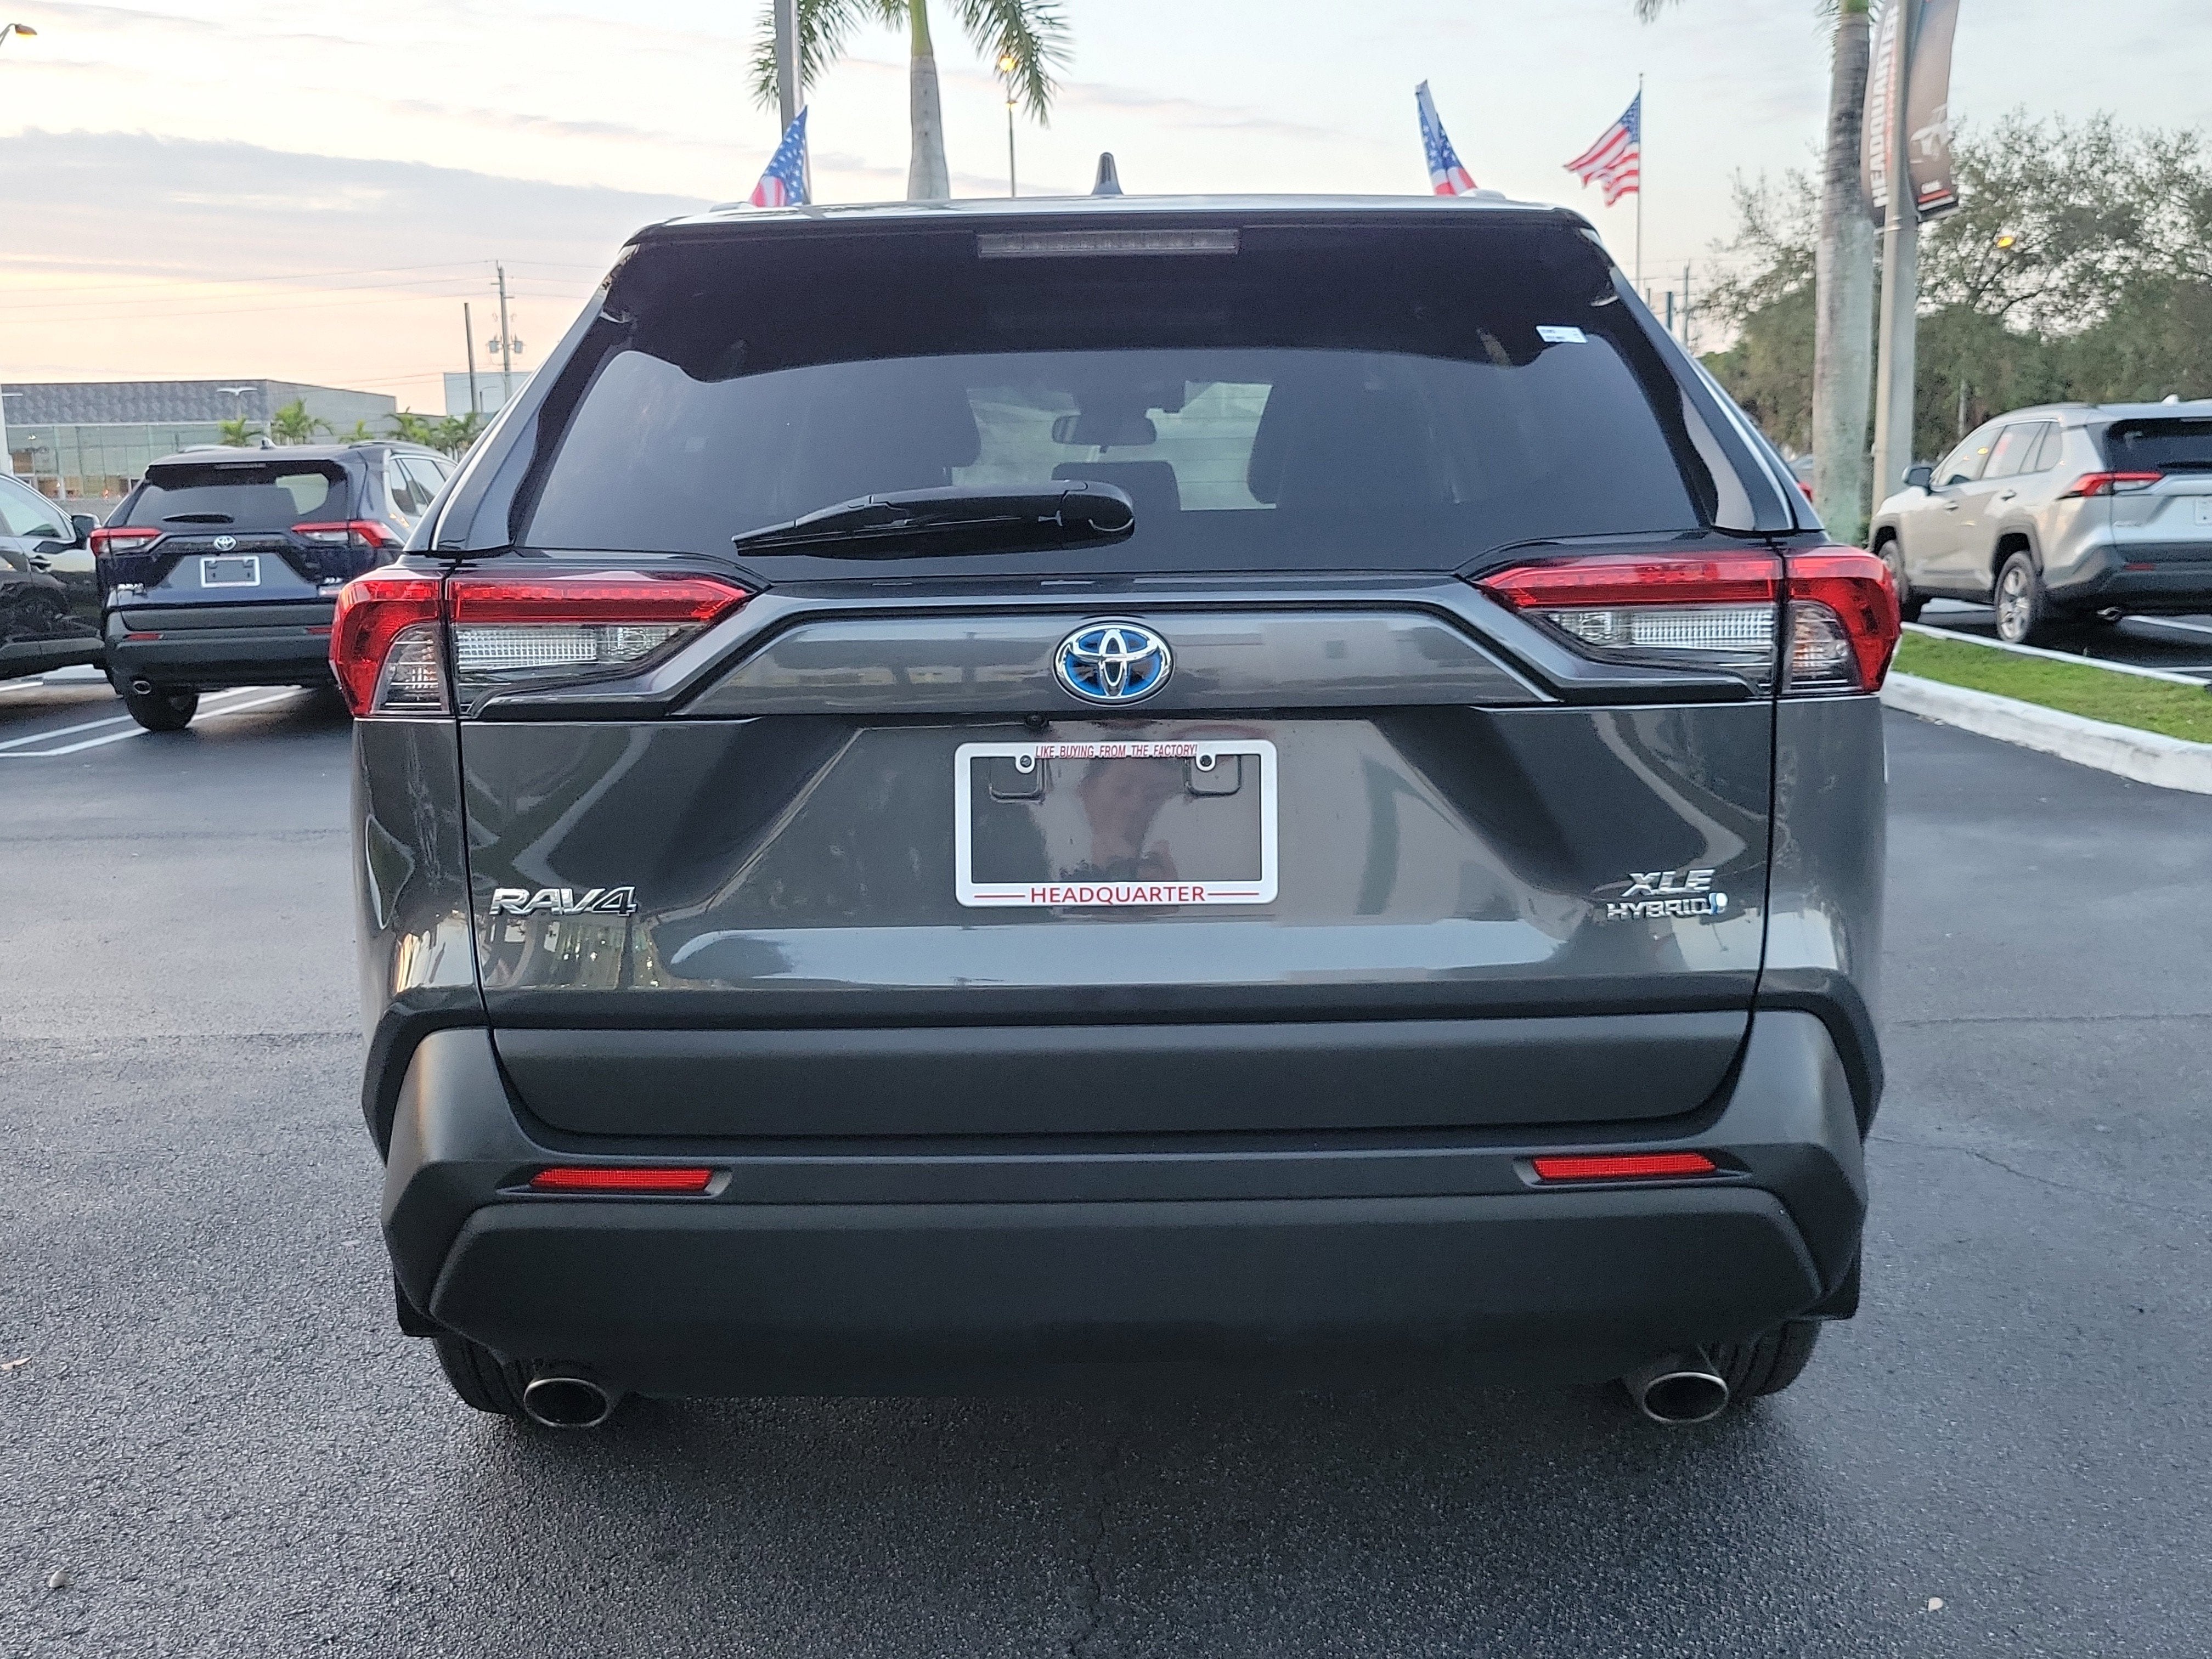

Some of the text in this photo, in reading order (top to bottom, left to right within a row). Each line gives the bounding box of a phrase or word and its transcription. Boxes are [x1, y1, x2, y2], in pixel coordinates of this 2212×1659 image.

[1035, 744, 1198, 757] LIKE BUYING FROM THE FACTORY!
[1621, 869, 1716, 897] XLE
[489, 886, 637, 917] RAV4
[1031, 887, 1205, 905] HEADQUARTER
[1607, 898, 1711, 920] HYBRID
